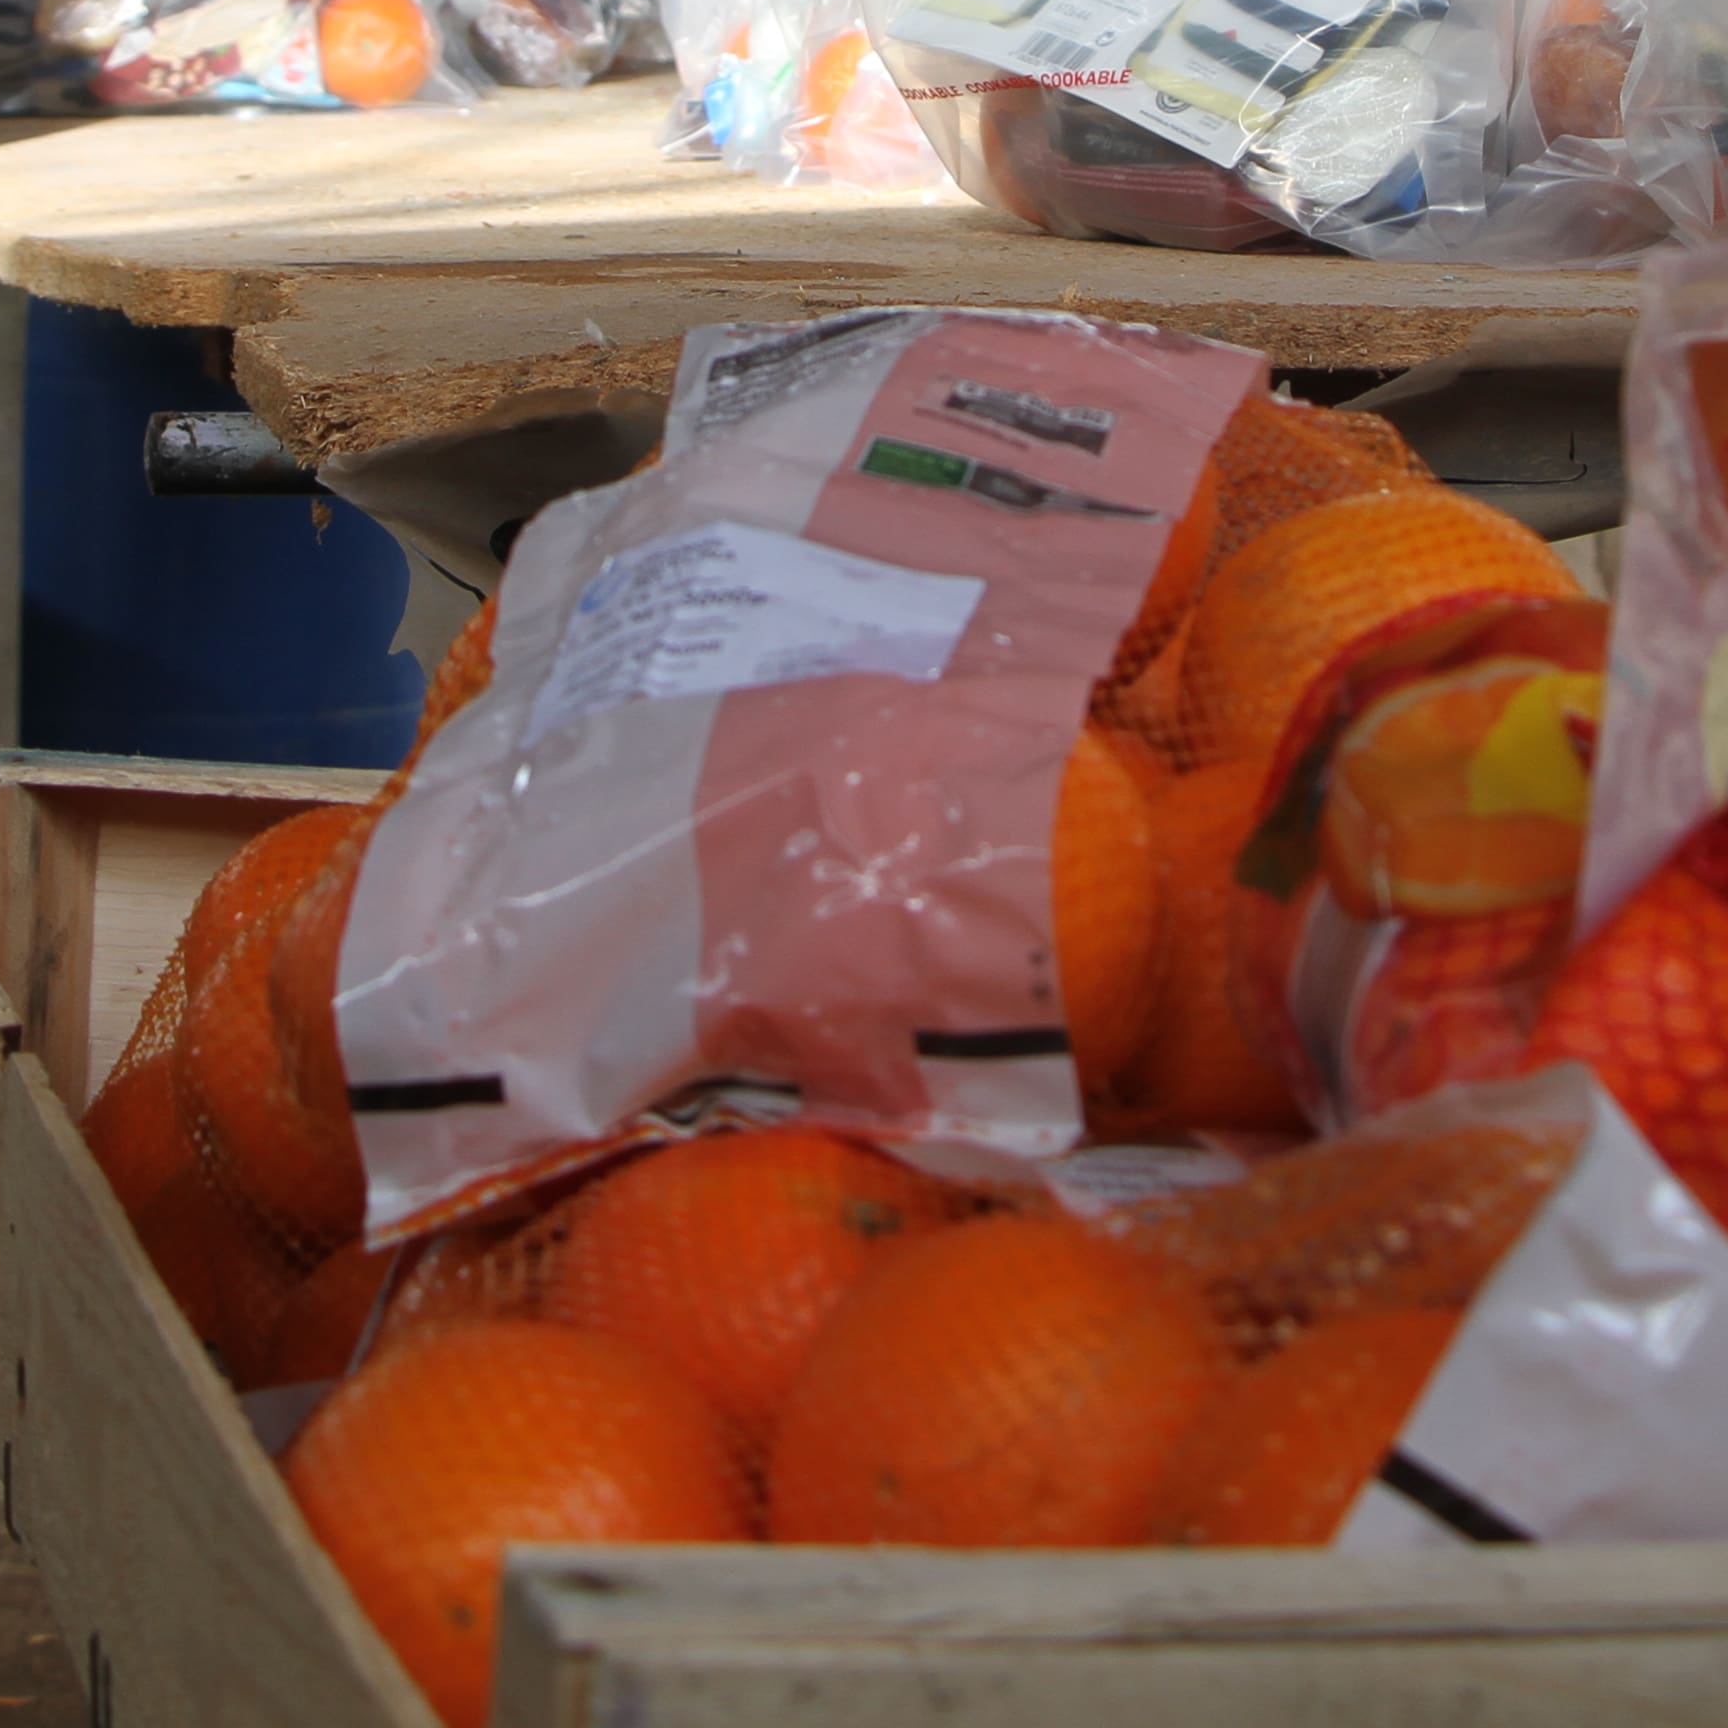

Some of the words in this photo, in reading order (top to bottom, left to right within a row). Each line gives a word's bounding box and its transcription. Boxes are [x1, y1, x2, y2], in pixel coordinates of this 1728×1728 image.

[901, 85, 963, 101] COOKABLE
[965, 74, 1040, 94] COOKABLE
[1040, 68, 1133, 89] COOKABLE
